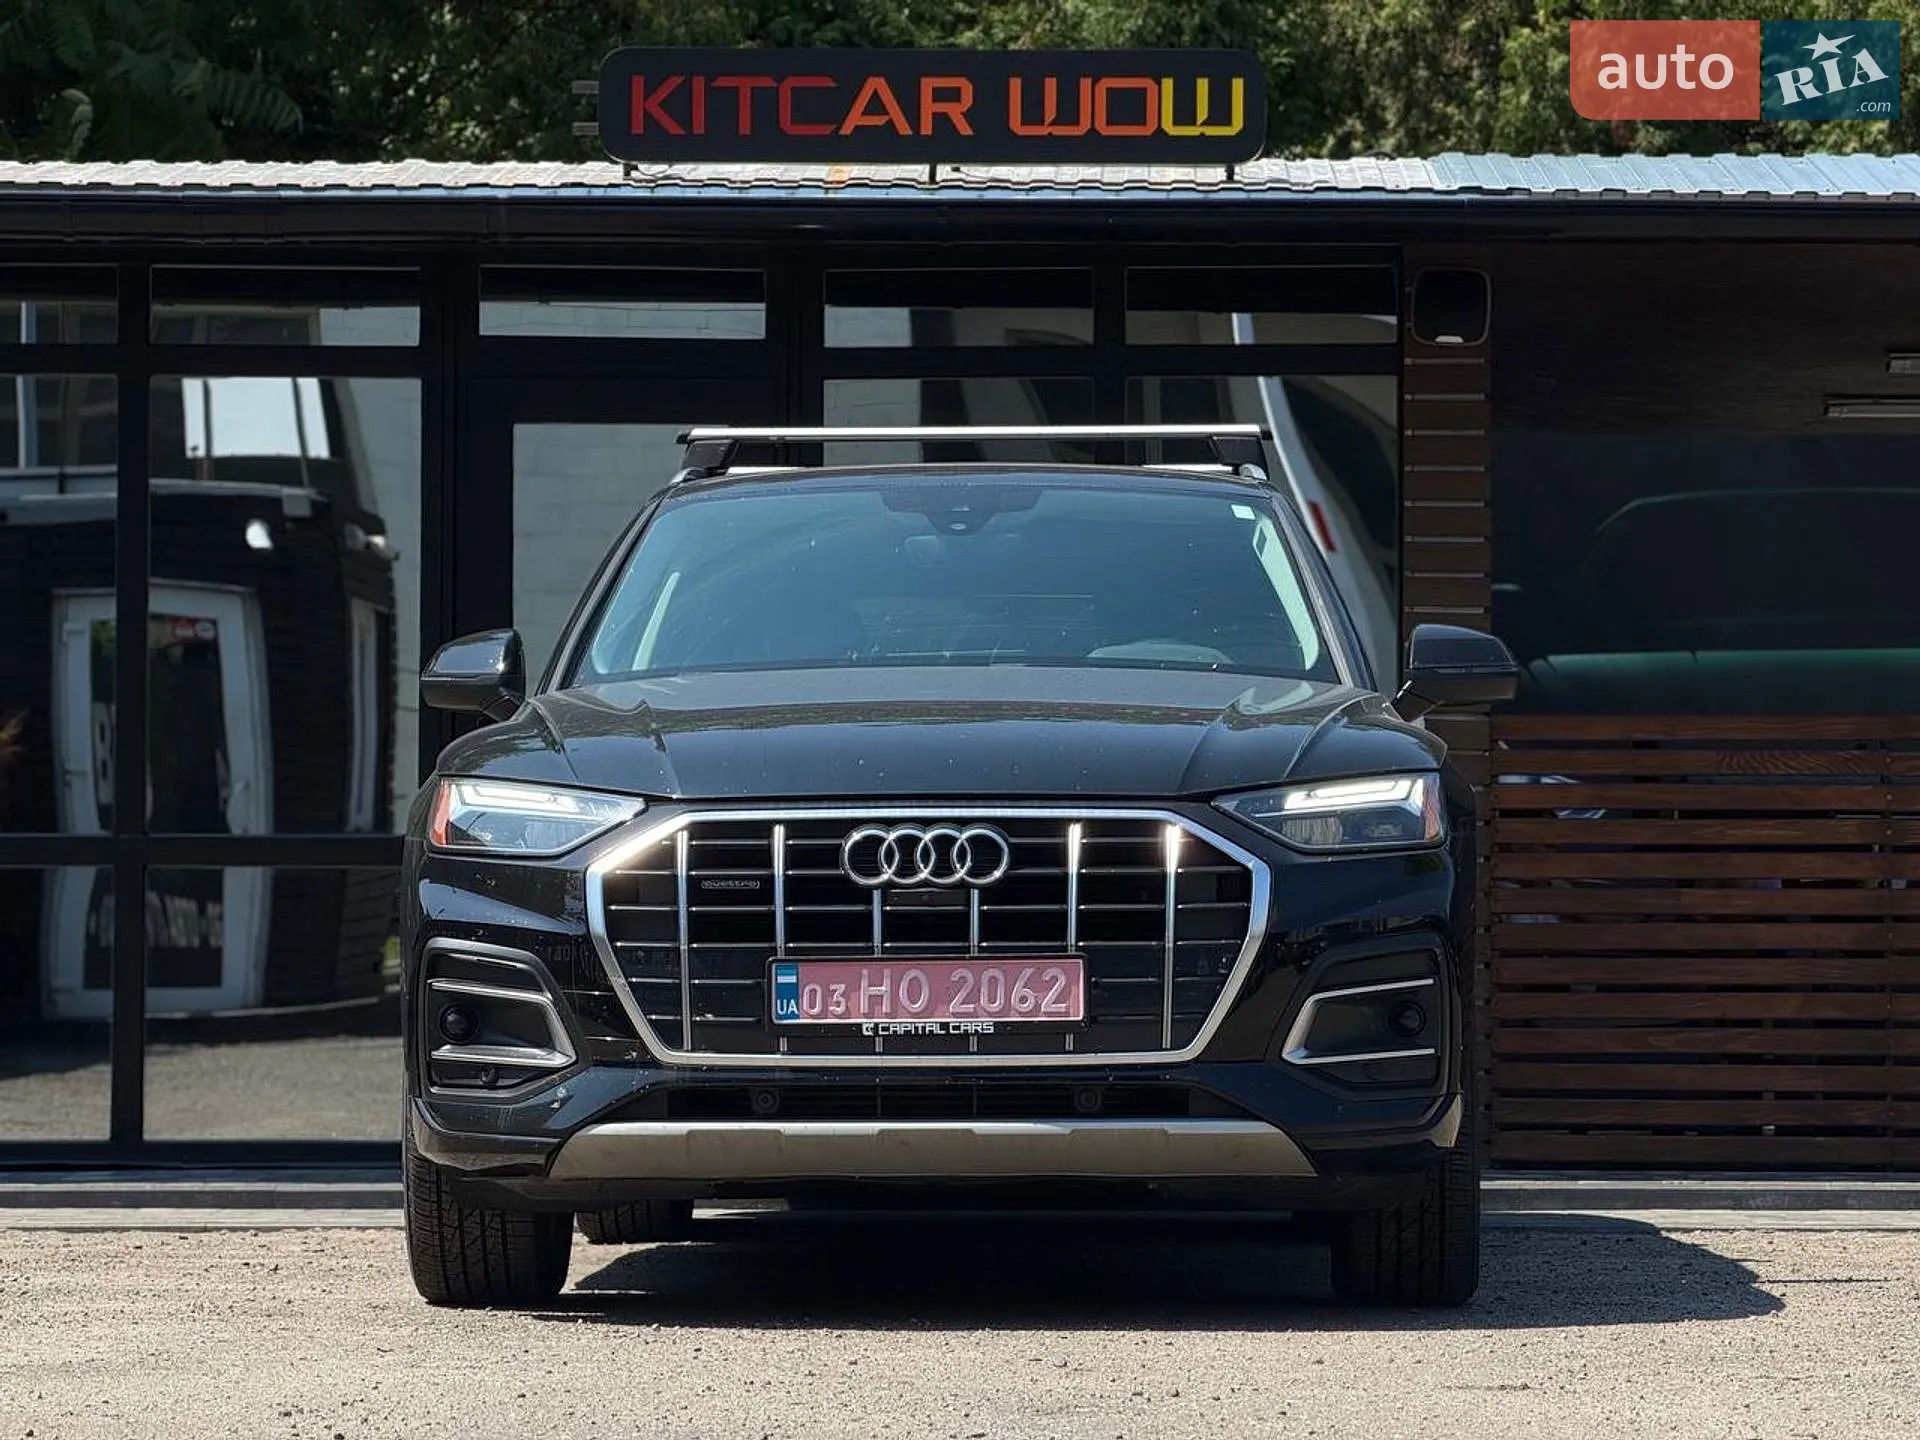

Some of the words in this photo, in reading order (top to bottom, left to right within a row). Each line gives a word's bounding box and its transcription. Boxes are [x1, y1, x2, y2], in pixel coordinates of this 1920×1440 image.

[630, 76, 974, 136] KITCAR
[1008, 77, 1245, 137] WOW
[777, 1000, 798, 1014] UA
[802, 983, 848, 1016] 03
[860, 969, 930, 1013] HO
[949, 967, 1068, 1014] 2062
[878, 1023, 946, 1035] CAPITAL
[949, 1022, 994, 1034] CARS
